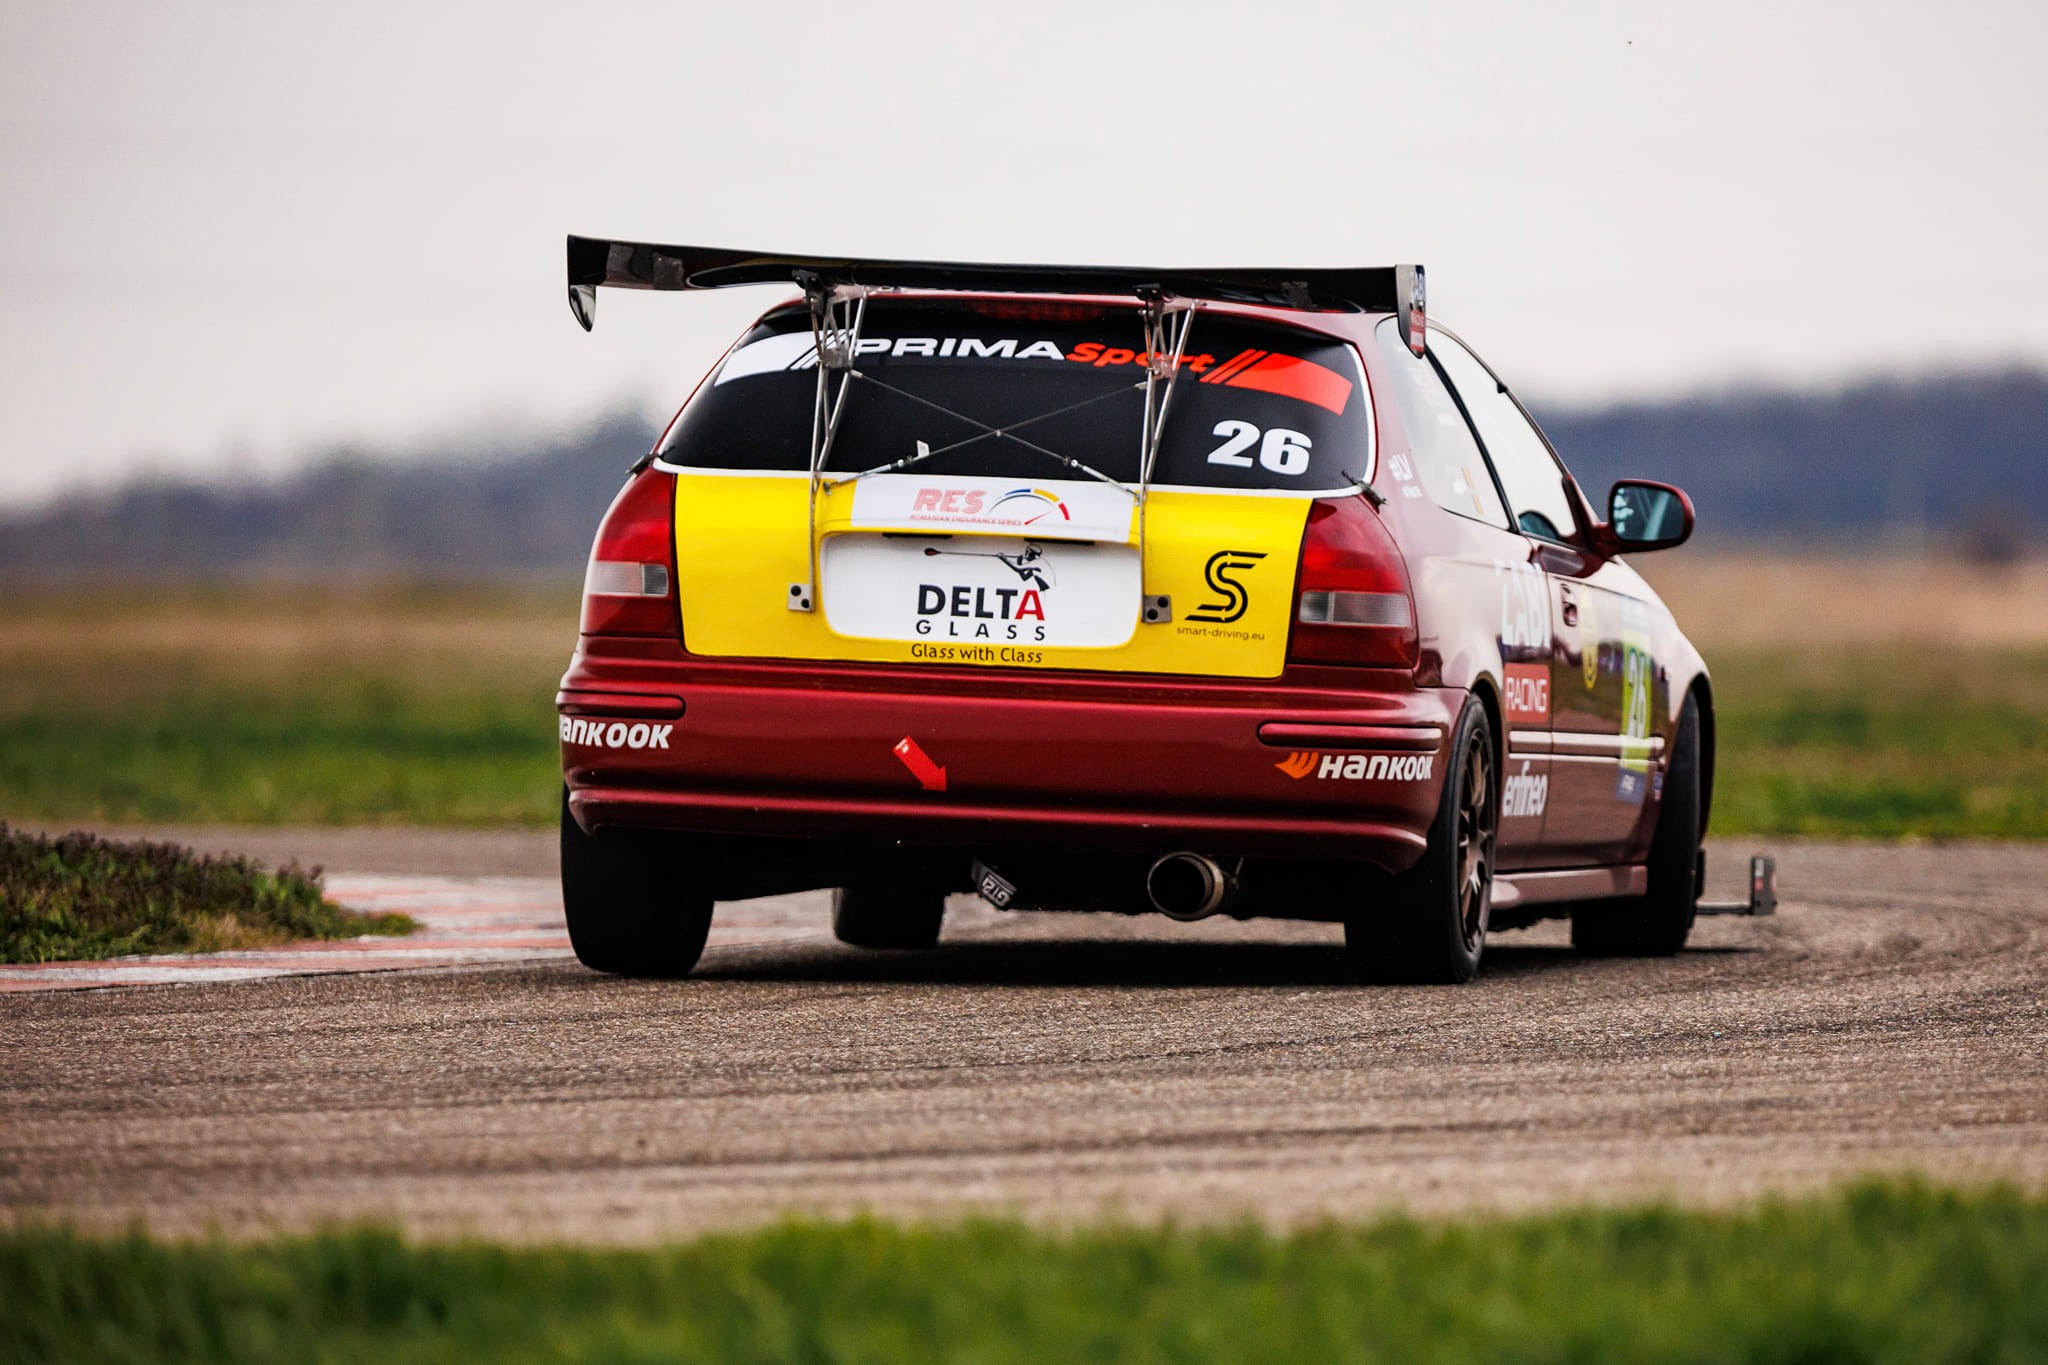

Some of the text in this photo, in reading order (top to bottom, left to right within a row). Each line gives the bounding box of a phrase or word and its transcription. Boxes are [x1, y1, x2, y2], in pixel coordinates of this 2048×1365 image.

[1207, 419, 1313, 476] 26
[912, 487, 988, 514] RES
[917, 584, 1046, 621] DELTA
[915, 619, 1046, 642] GLASS
[1176, 627, 1265, 641] smart-driving.eu
[911, 643, 1043, 663] Glass with Class
[1506, 677, 1547, 713] RACING
